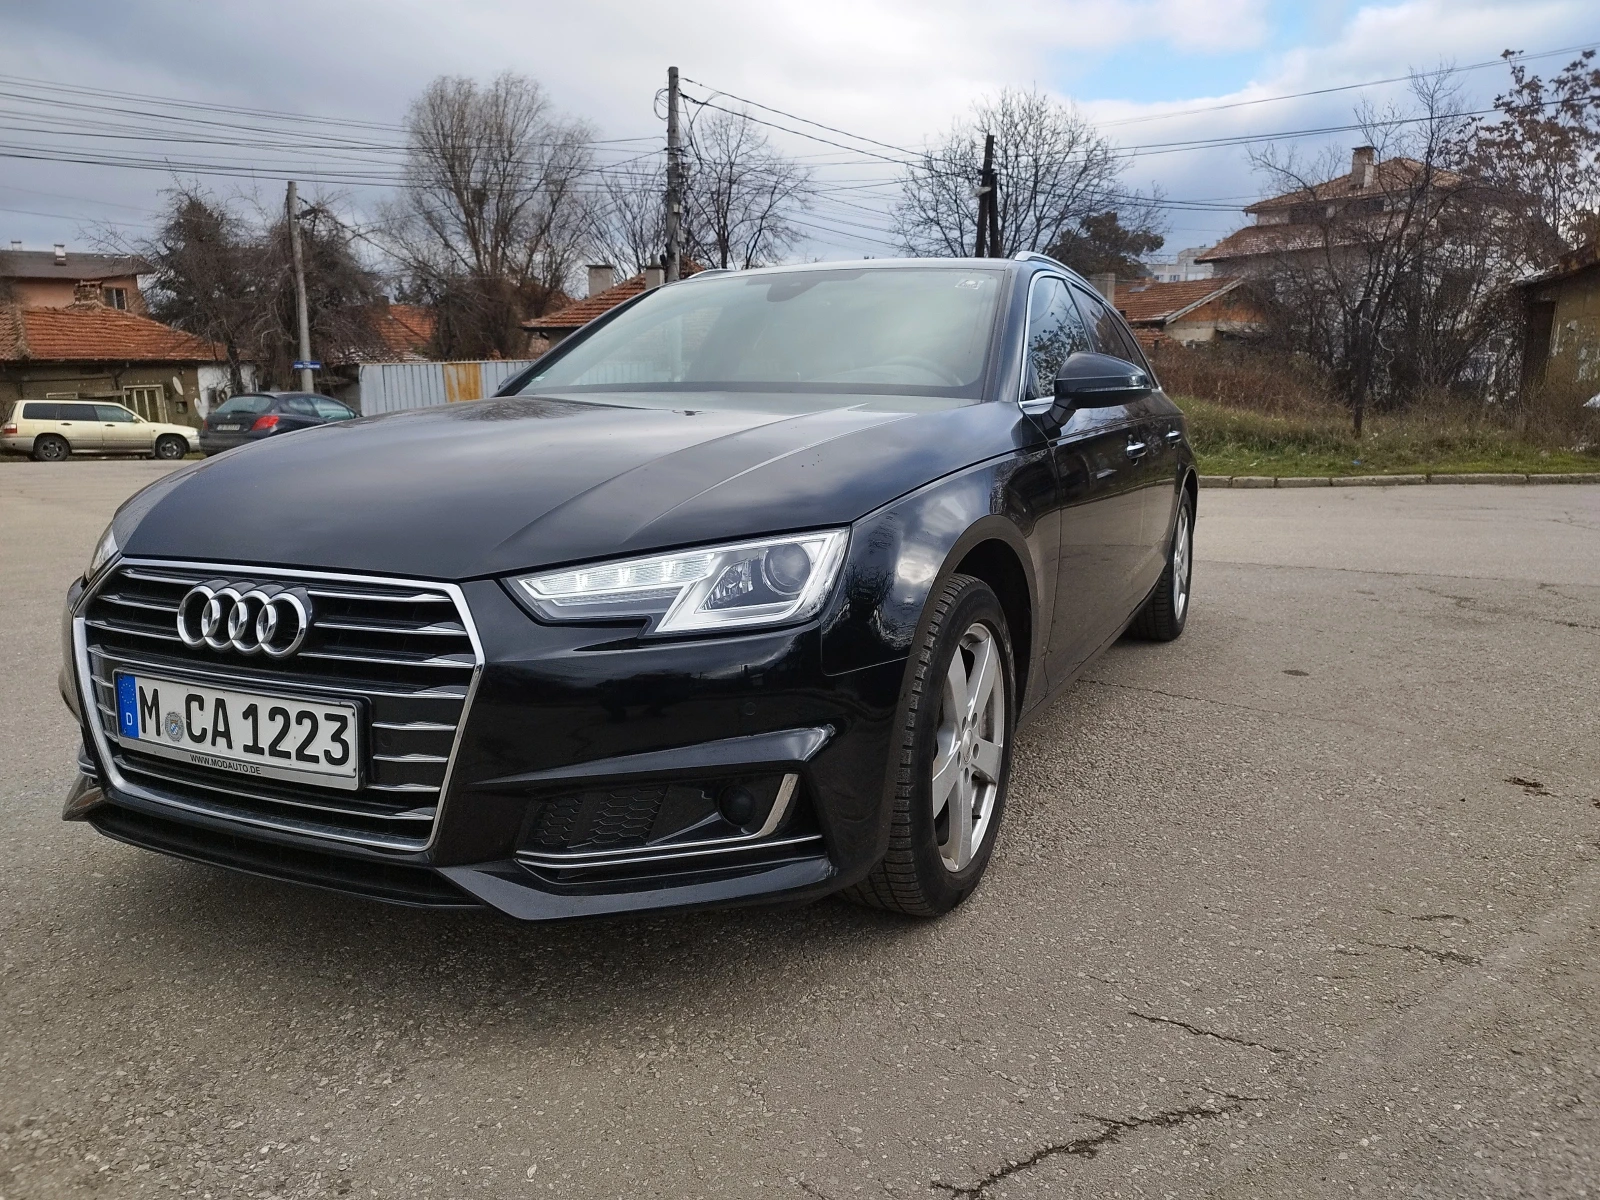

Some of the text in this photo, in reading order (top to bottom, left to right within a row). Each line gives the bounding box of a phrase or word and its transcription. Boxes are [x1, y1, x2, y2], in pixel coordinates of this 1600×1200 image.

[126, 712, 133, 726] D
[138, 685, 161, 737] M
[184, 693, 233, 749] CA
[242, 703, 350, 766] 1223
[189, 754, 262, 775] WWW.MODAUTO.DE
